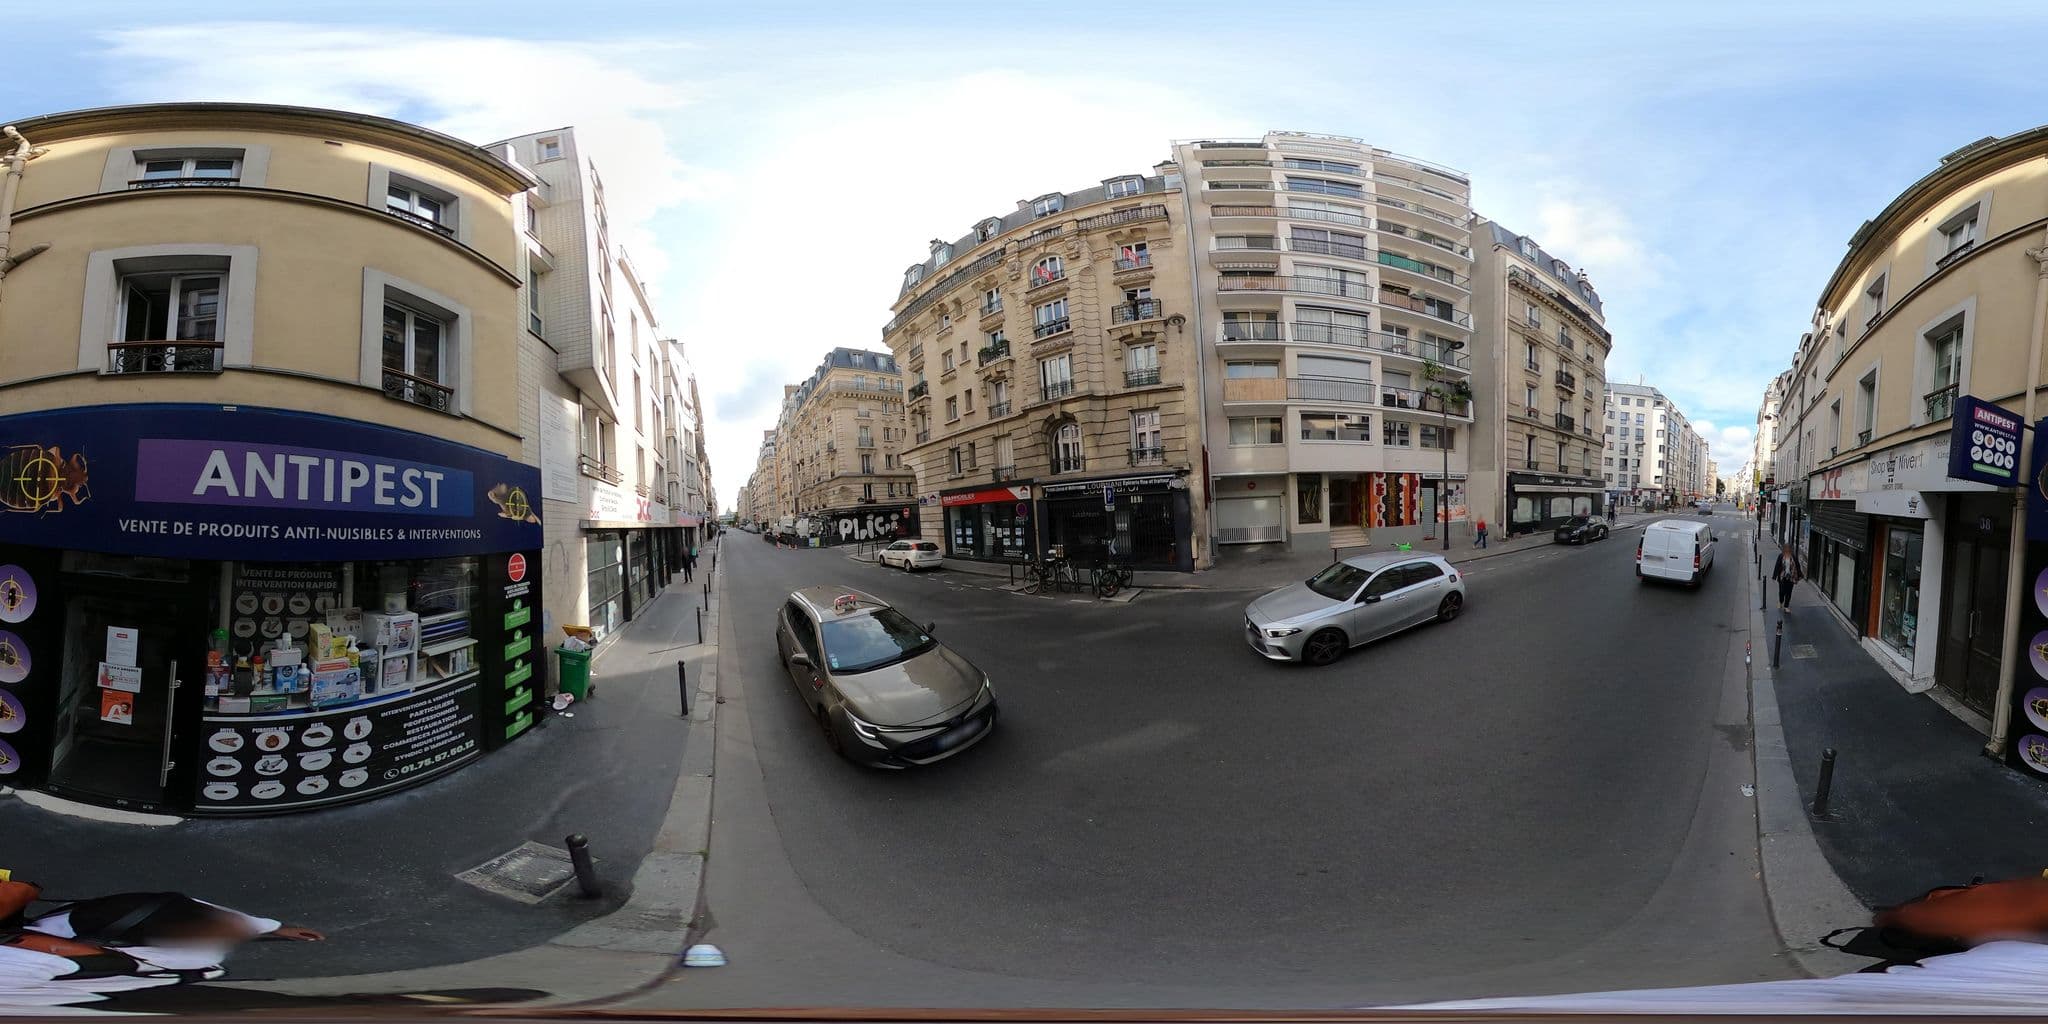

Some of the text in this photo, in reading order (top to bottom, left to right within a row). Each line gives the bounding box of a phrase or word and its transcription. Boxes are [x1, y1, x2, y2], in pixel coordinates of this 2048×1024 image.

[1977, 409, 2016, 430] ANTIPEST
[192, 449, 444, 509] ANTIPEST
[119, 519, 481, 540] VENTE DE PRODUITS ANTI-NUISIBLES & INTERVENTIONS
[236, 579, 337, 589] INTERVENTION RAPIDE
[243, 569, 332, 579] VENTE DE PRODUITS
[403, 705, 459, 729] PROFESSIONNELS
[409, 699, 455, 719] PARTICULIERS
[407, 714, 457, 736] RESTAURATION
[383, 732, 431, 750] COMMERCES
[411, 730, 453, 749] INDUSTRIELS
[394, 748, 423, 762] SYNDIC
